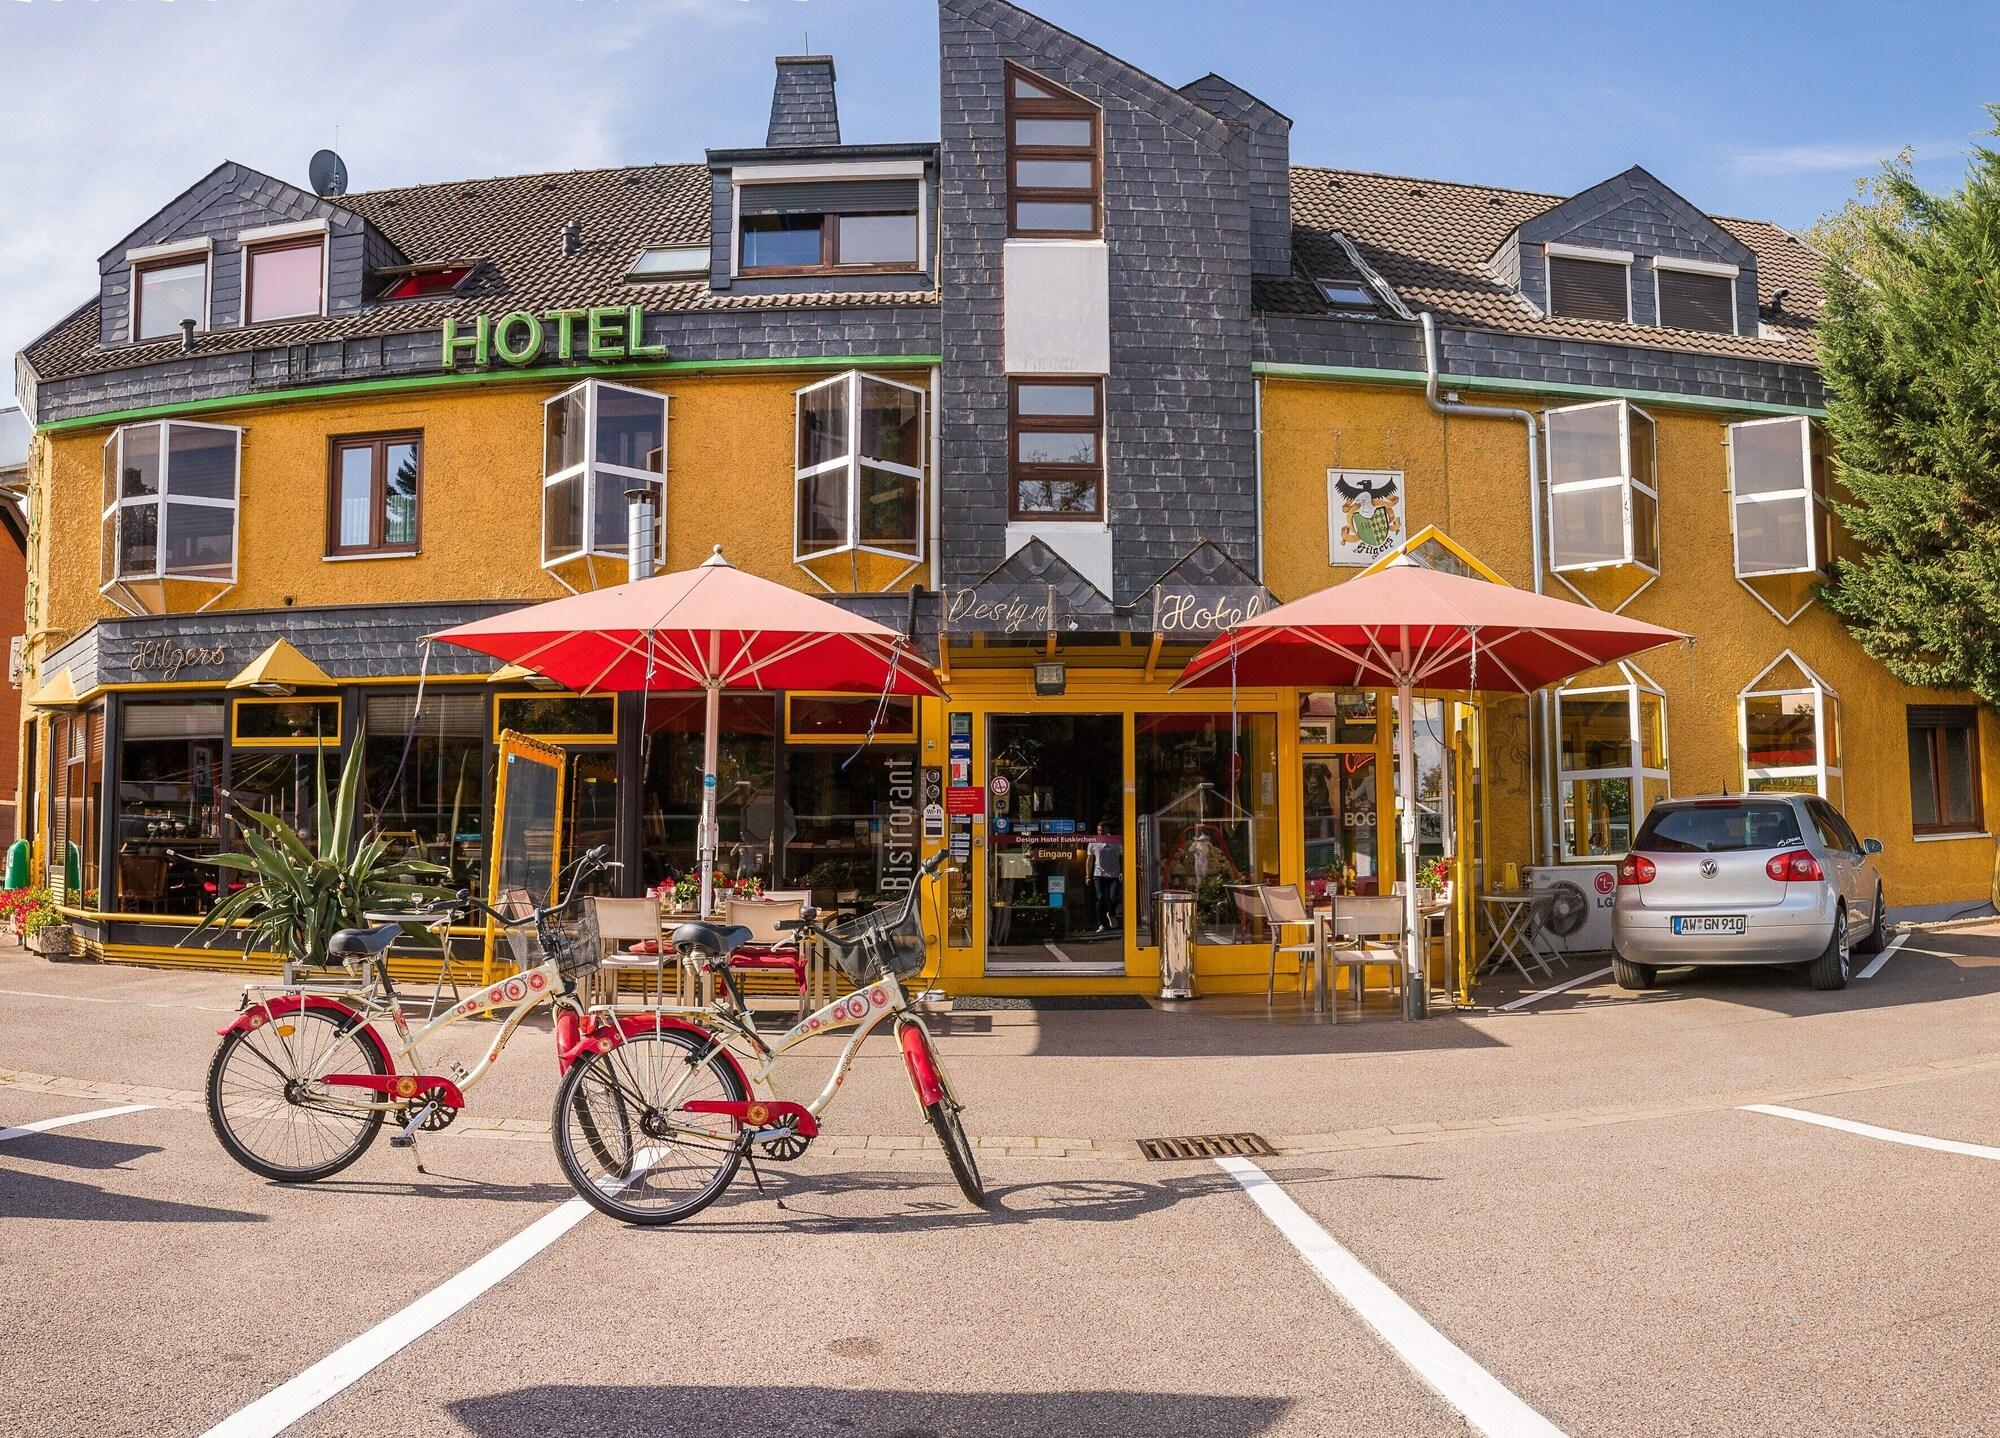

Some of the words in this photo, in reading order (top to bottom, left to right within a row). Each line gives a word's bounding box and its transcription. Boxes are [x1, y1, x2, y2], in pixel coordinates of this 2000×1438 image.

[441, 303, 668, 368] HOTEL
[948, 588, 1049, 634] Design
[1162, 594, 1259, 630] Hotel
[130, 639, 225, 681] Hilgers
[880, 758, 913, 890] Bistrorant
[1038, 849, 1073, 860] Eingang
[1596, 897, 1614, 908] LG
[1681, 918, 1697, 931] AW
[1703, 918, 1720, 930] GN
[1721, 918, 1744, 930] 910
